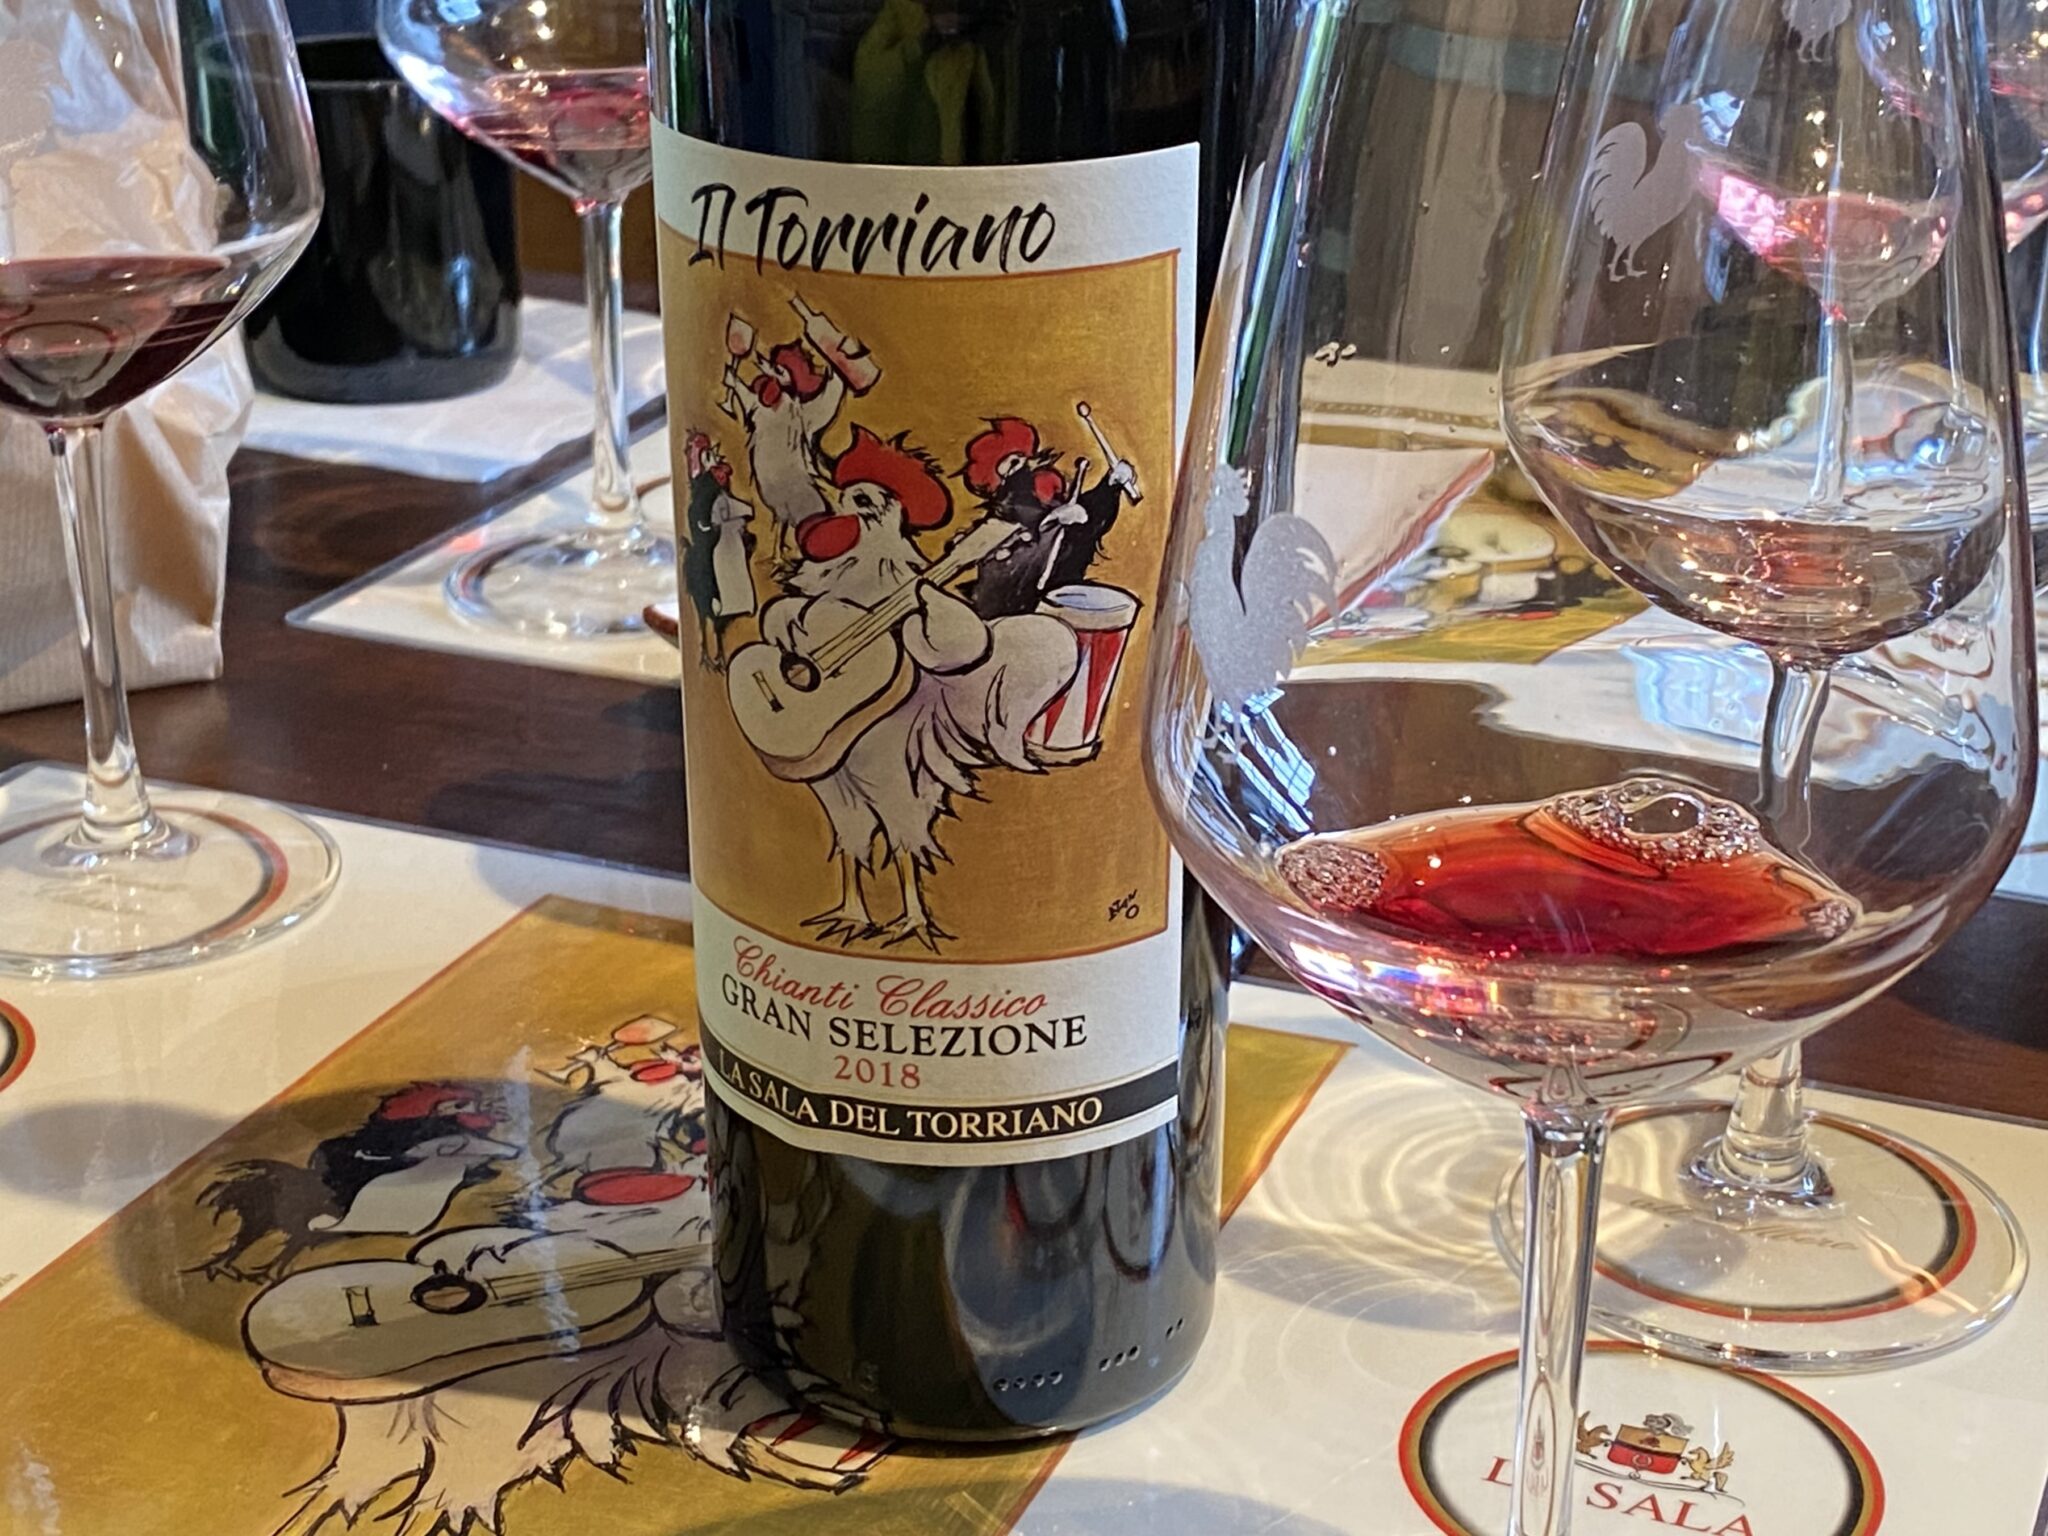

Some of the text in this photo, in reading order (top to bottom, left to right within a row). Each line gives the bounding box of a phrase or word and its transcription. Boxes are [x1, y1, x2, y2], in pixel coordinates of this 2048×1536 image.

[688, 182, 1056, 276] Il Torriano
[722, 973, 1088, 1058] GRAN SELEZIONE
[733, 935, 1048, 1020] Chianti Classico
[719, 1048, 1103, 1139] LA SALA DEL TORRIANO
[834, 1054, 921, 1089] 2018
[1586, 1481, 1754, 1536] SALA
